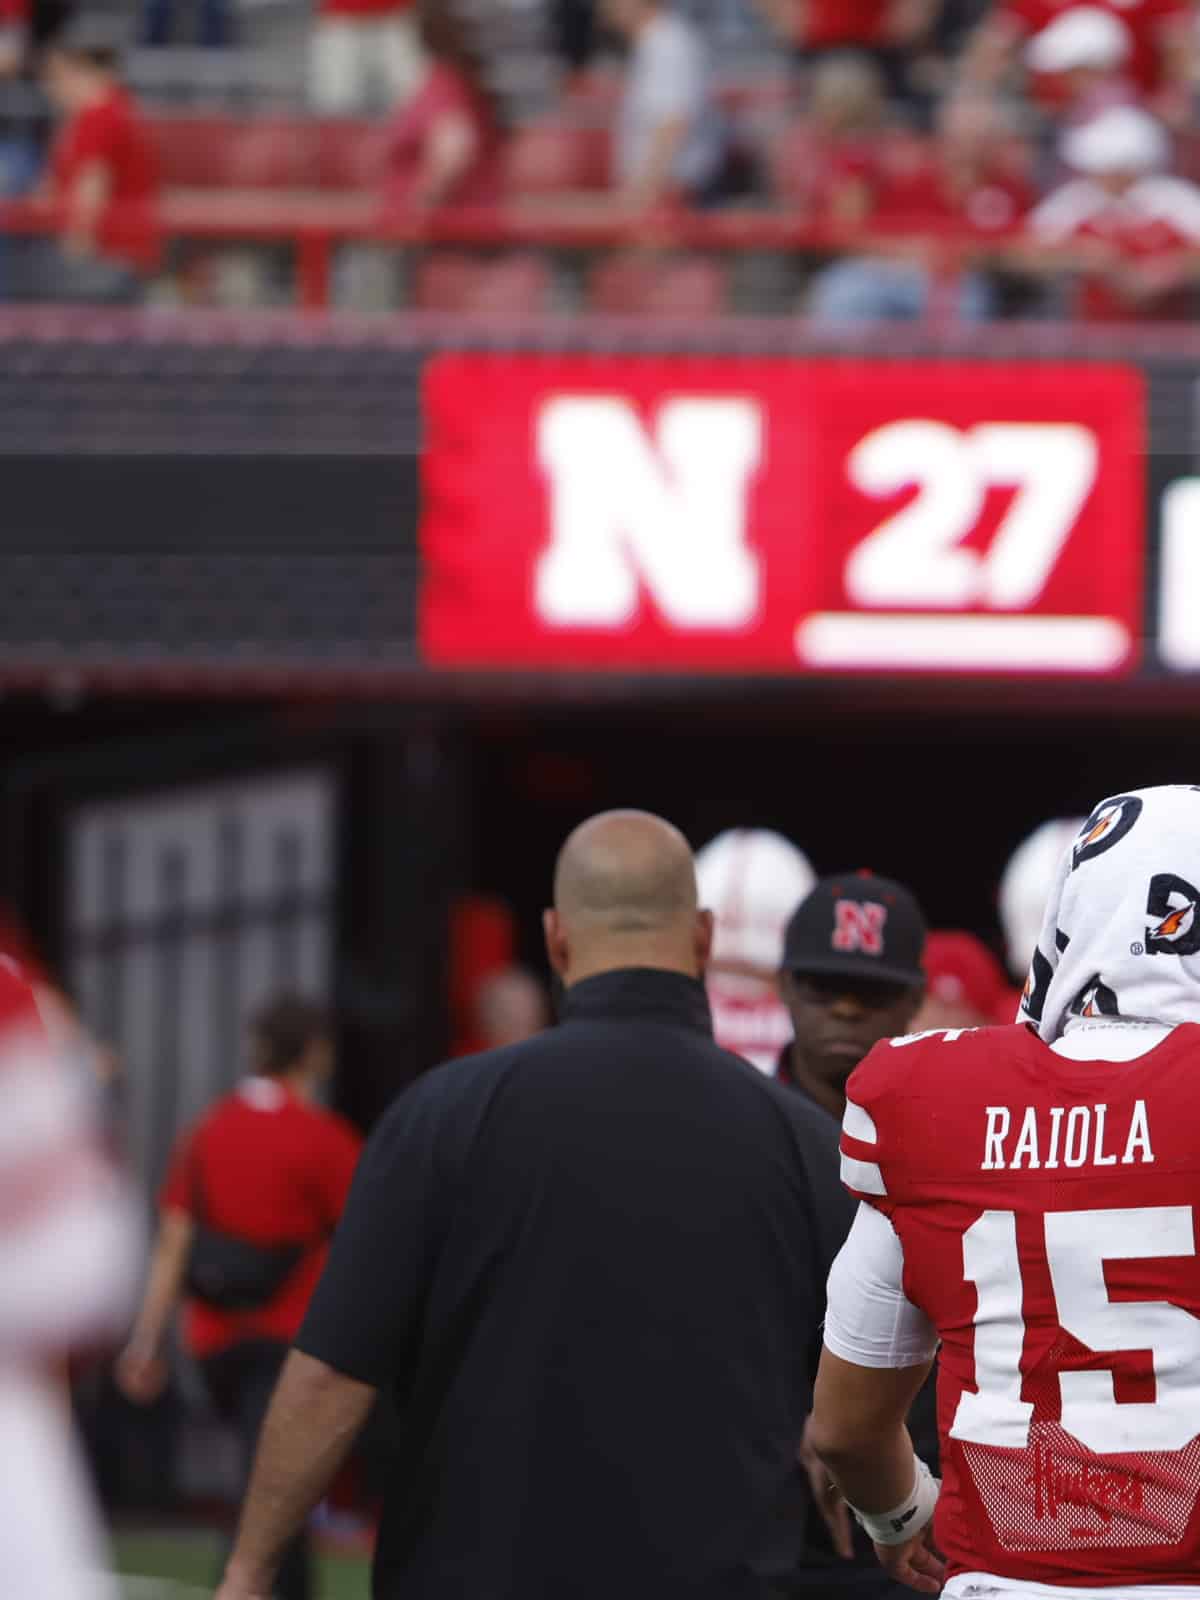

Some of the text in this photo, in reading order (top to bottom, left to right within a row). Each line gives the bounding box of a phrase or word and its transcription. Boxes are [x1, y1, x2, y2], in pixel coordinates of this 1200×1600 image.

[535, 395, 762, 630] N
[844, 418, 1100, 609] 27
[832, 899, 887, 955] N
[981, 1100, 1154, 1170] RAIOLA
